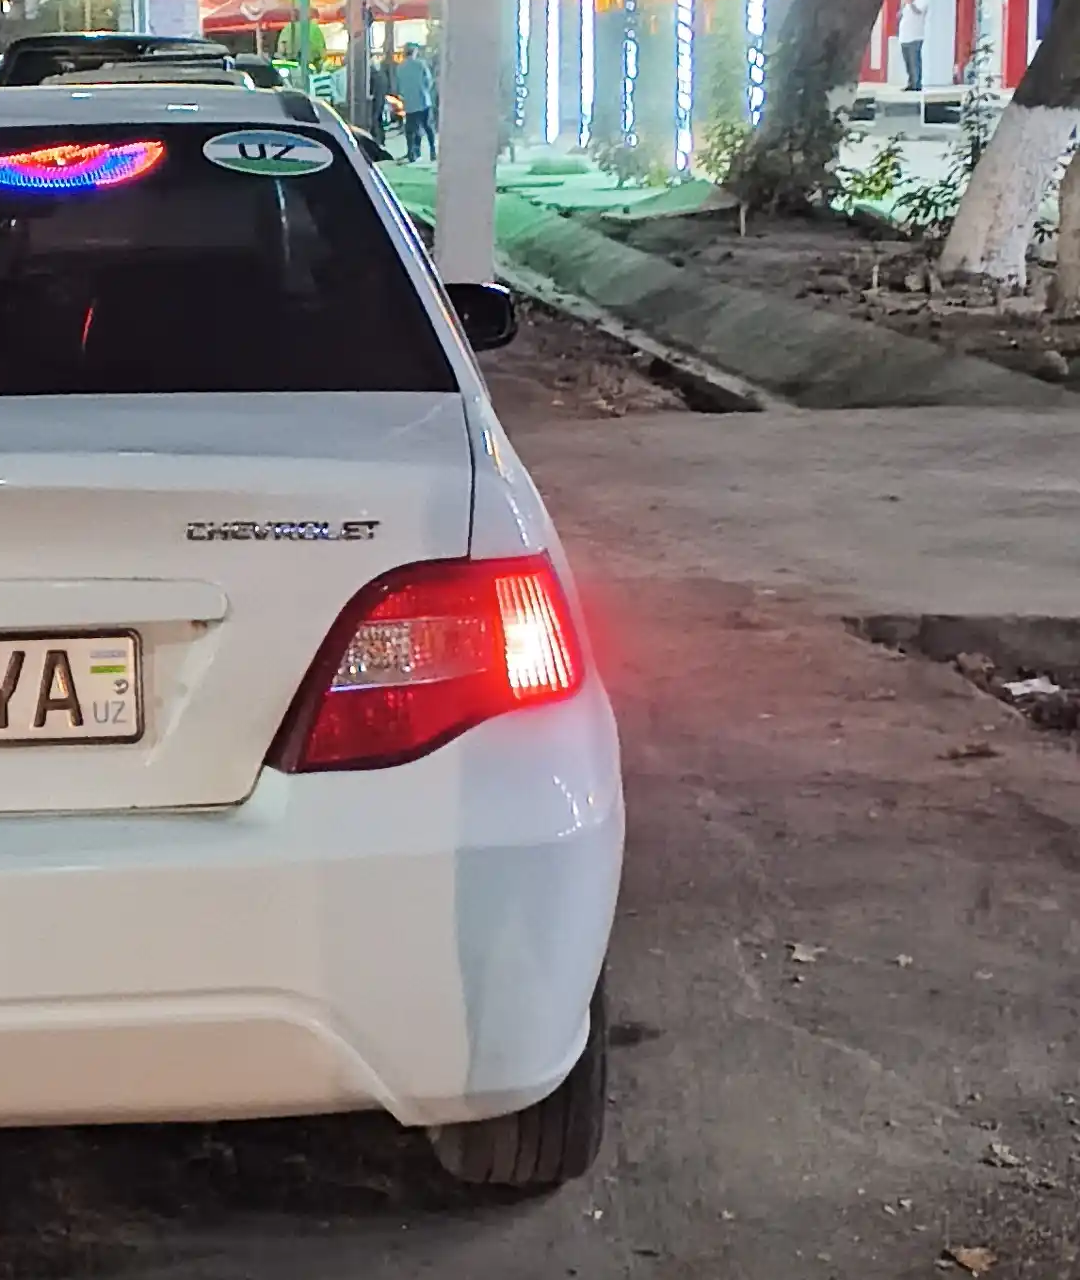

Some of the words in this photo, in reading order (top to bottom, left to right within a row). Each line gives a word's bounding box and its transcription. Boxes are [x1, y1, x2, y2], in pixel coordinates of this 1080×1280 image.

[238, 141, 299, 162] UZ
[186, 520, 380, 541] CHEVROLET
[92, 700, 126, 724] UZ
